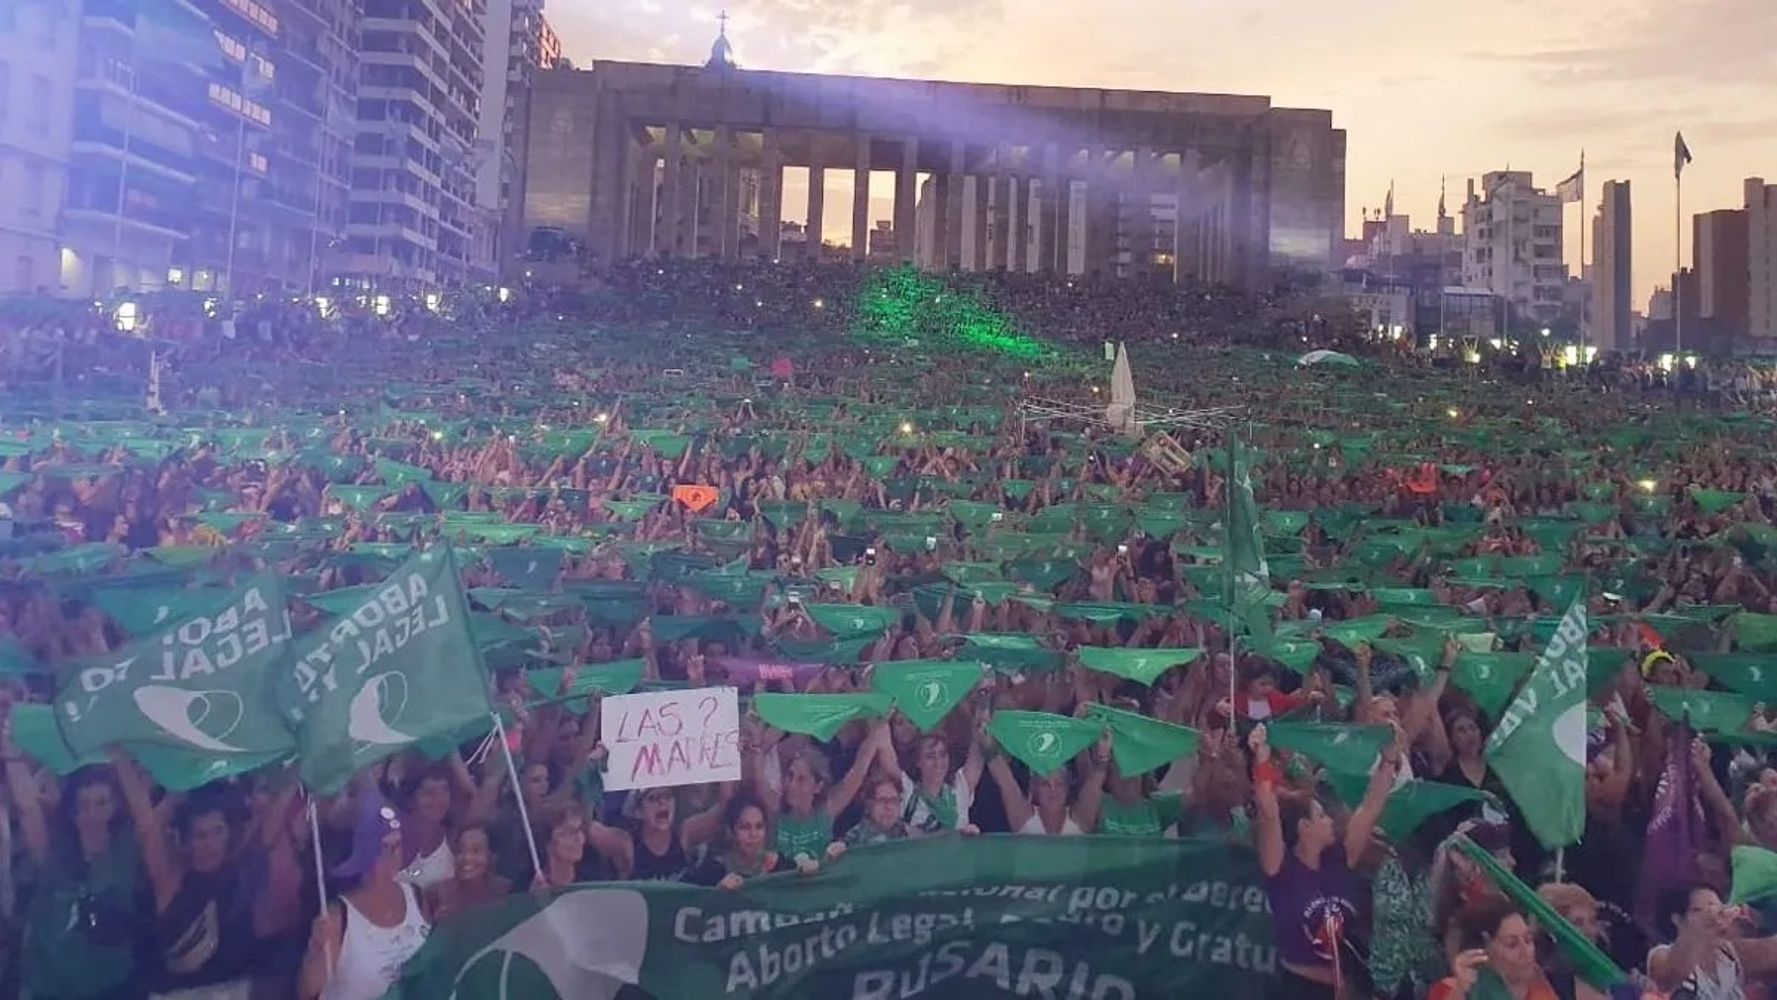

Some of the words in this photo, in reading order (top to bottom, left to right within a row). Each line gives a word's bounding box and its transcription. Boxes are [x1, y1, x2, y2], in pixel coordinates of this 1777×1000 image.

[615, 701, 683, 743] LAS
[1067, 885, 1138, 915] por
[725, 923, 858, 994] Aborto
